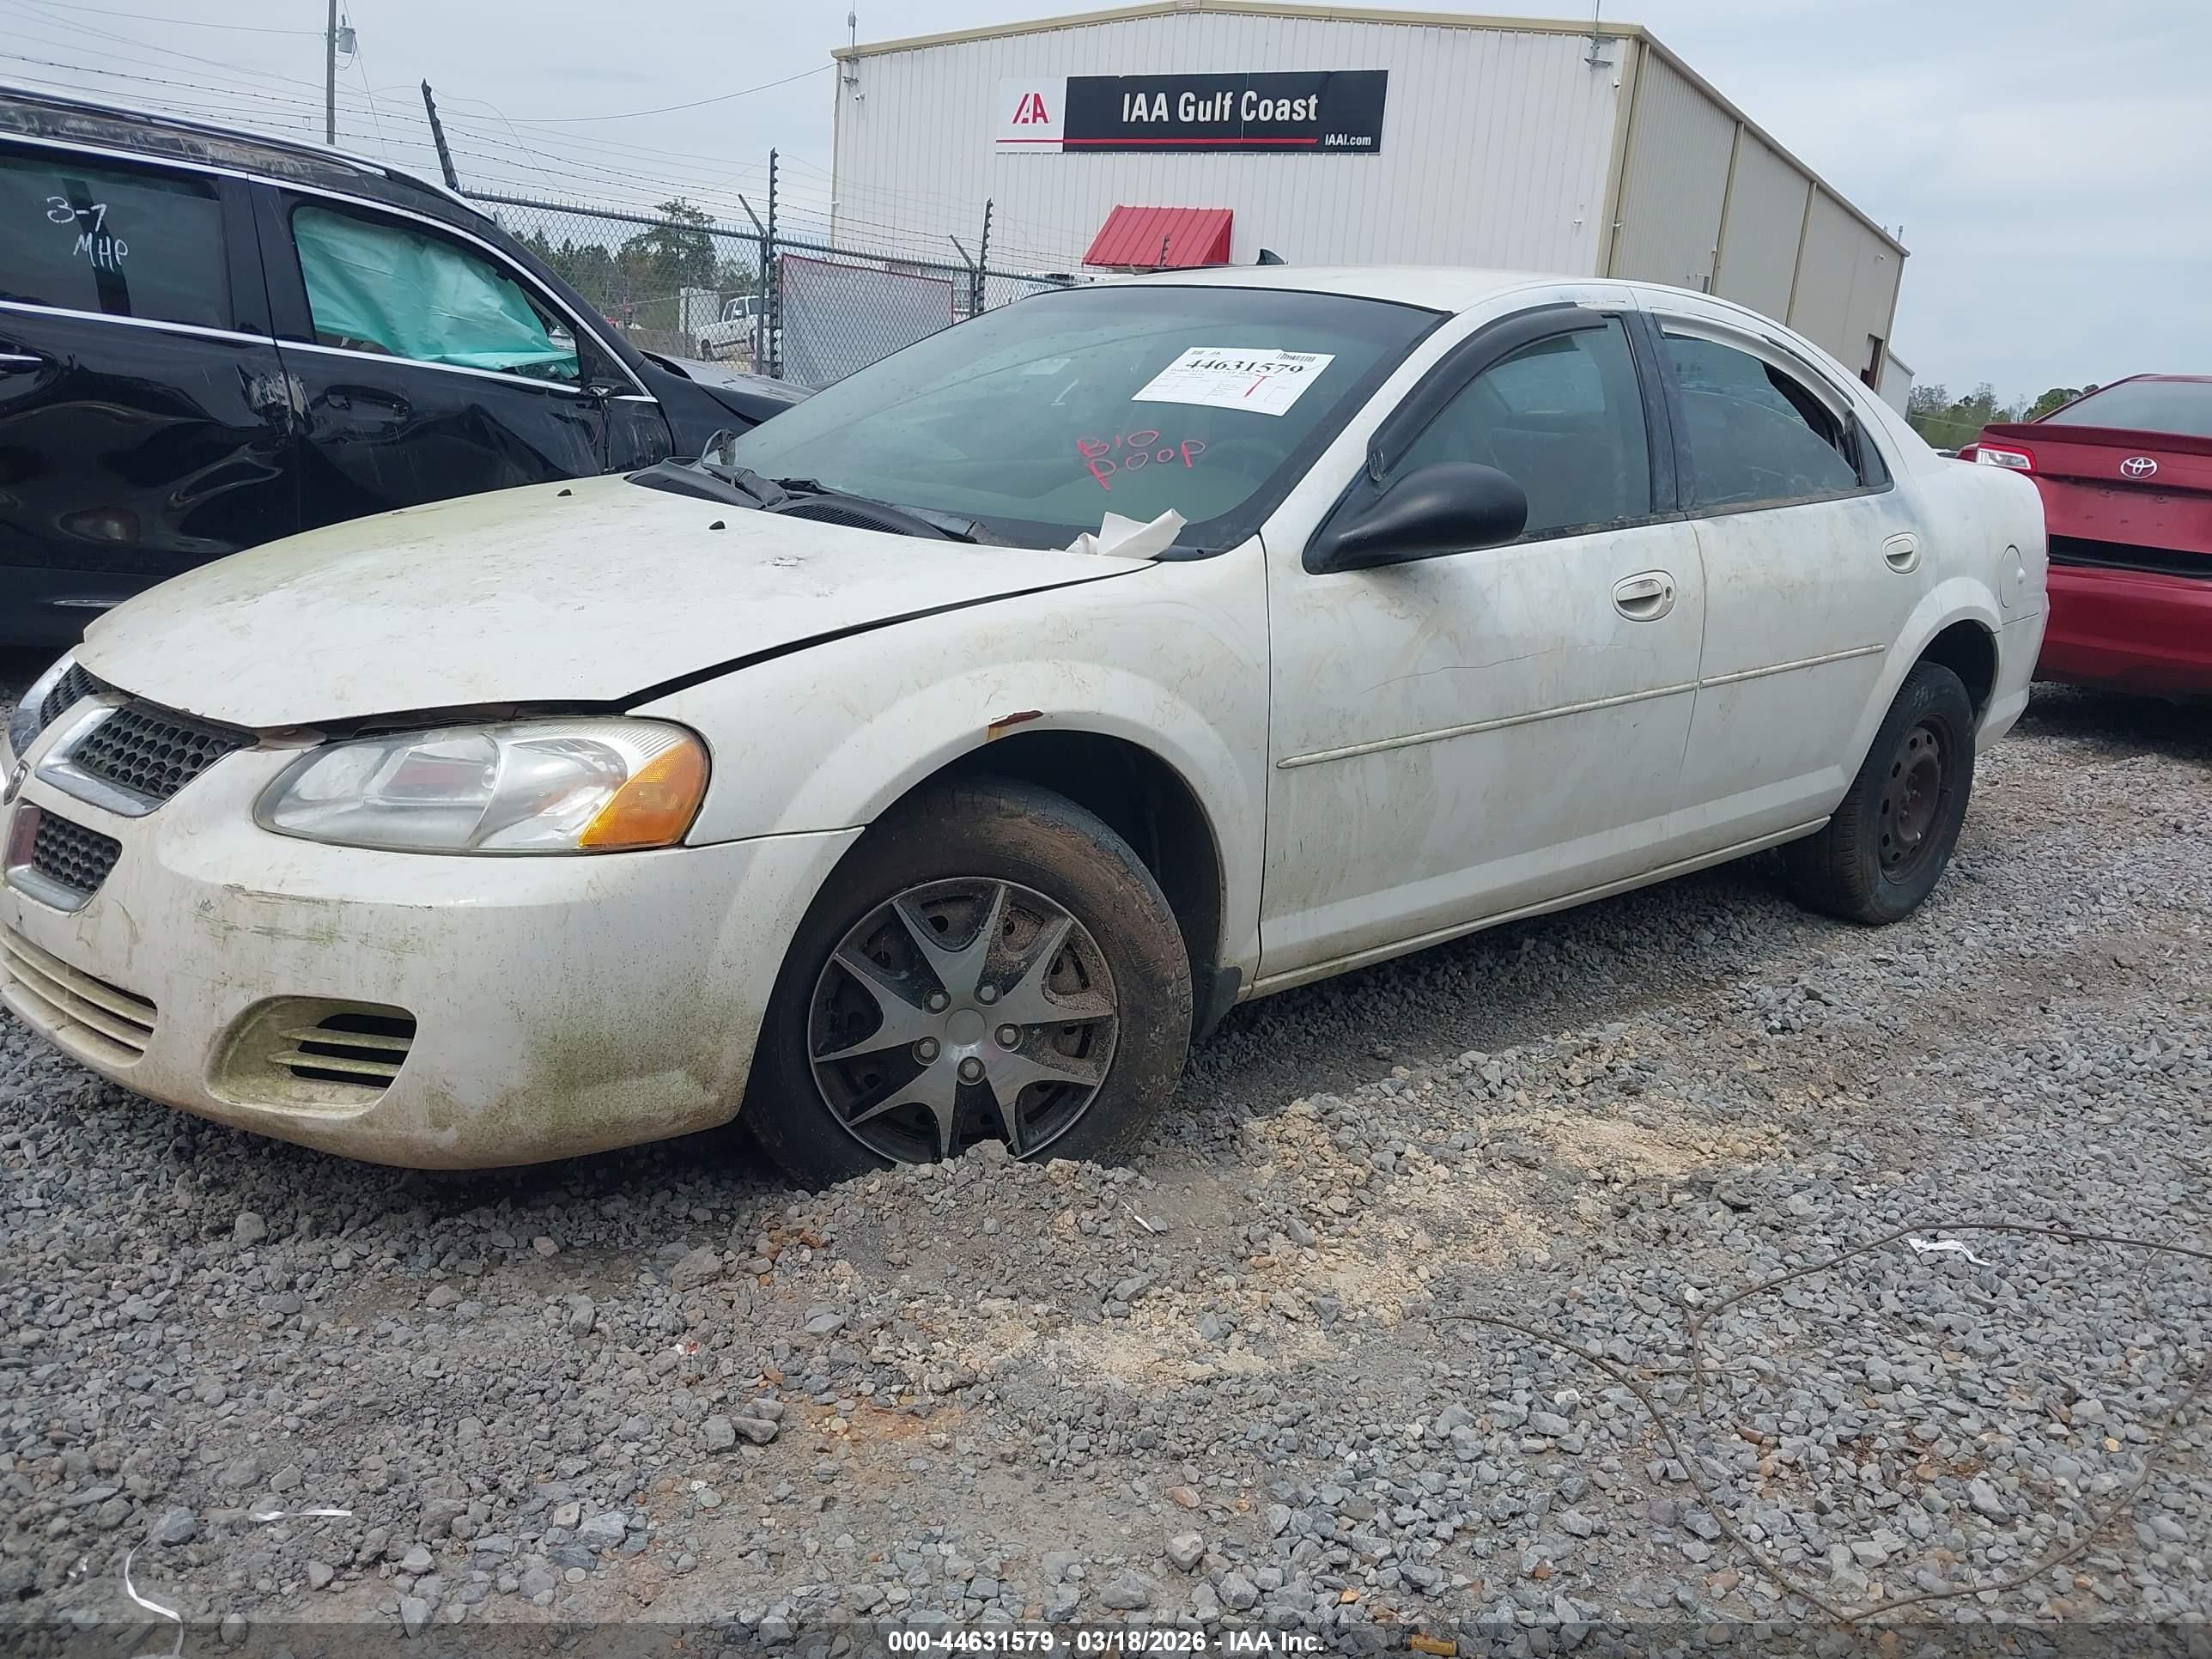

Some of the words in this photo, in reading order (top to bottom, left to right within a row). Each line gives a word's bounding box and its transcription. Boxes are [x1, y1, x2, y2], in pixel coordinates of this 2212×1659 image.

[1122, 92, 1169, 122] IAA
[1177, 91, 1234, 122] Gulf
[1241, 90, 1319, 121] Coast
[1185, 358, 1304, 374] 44631579
